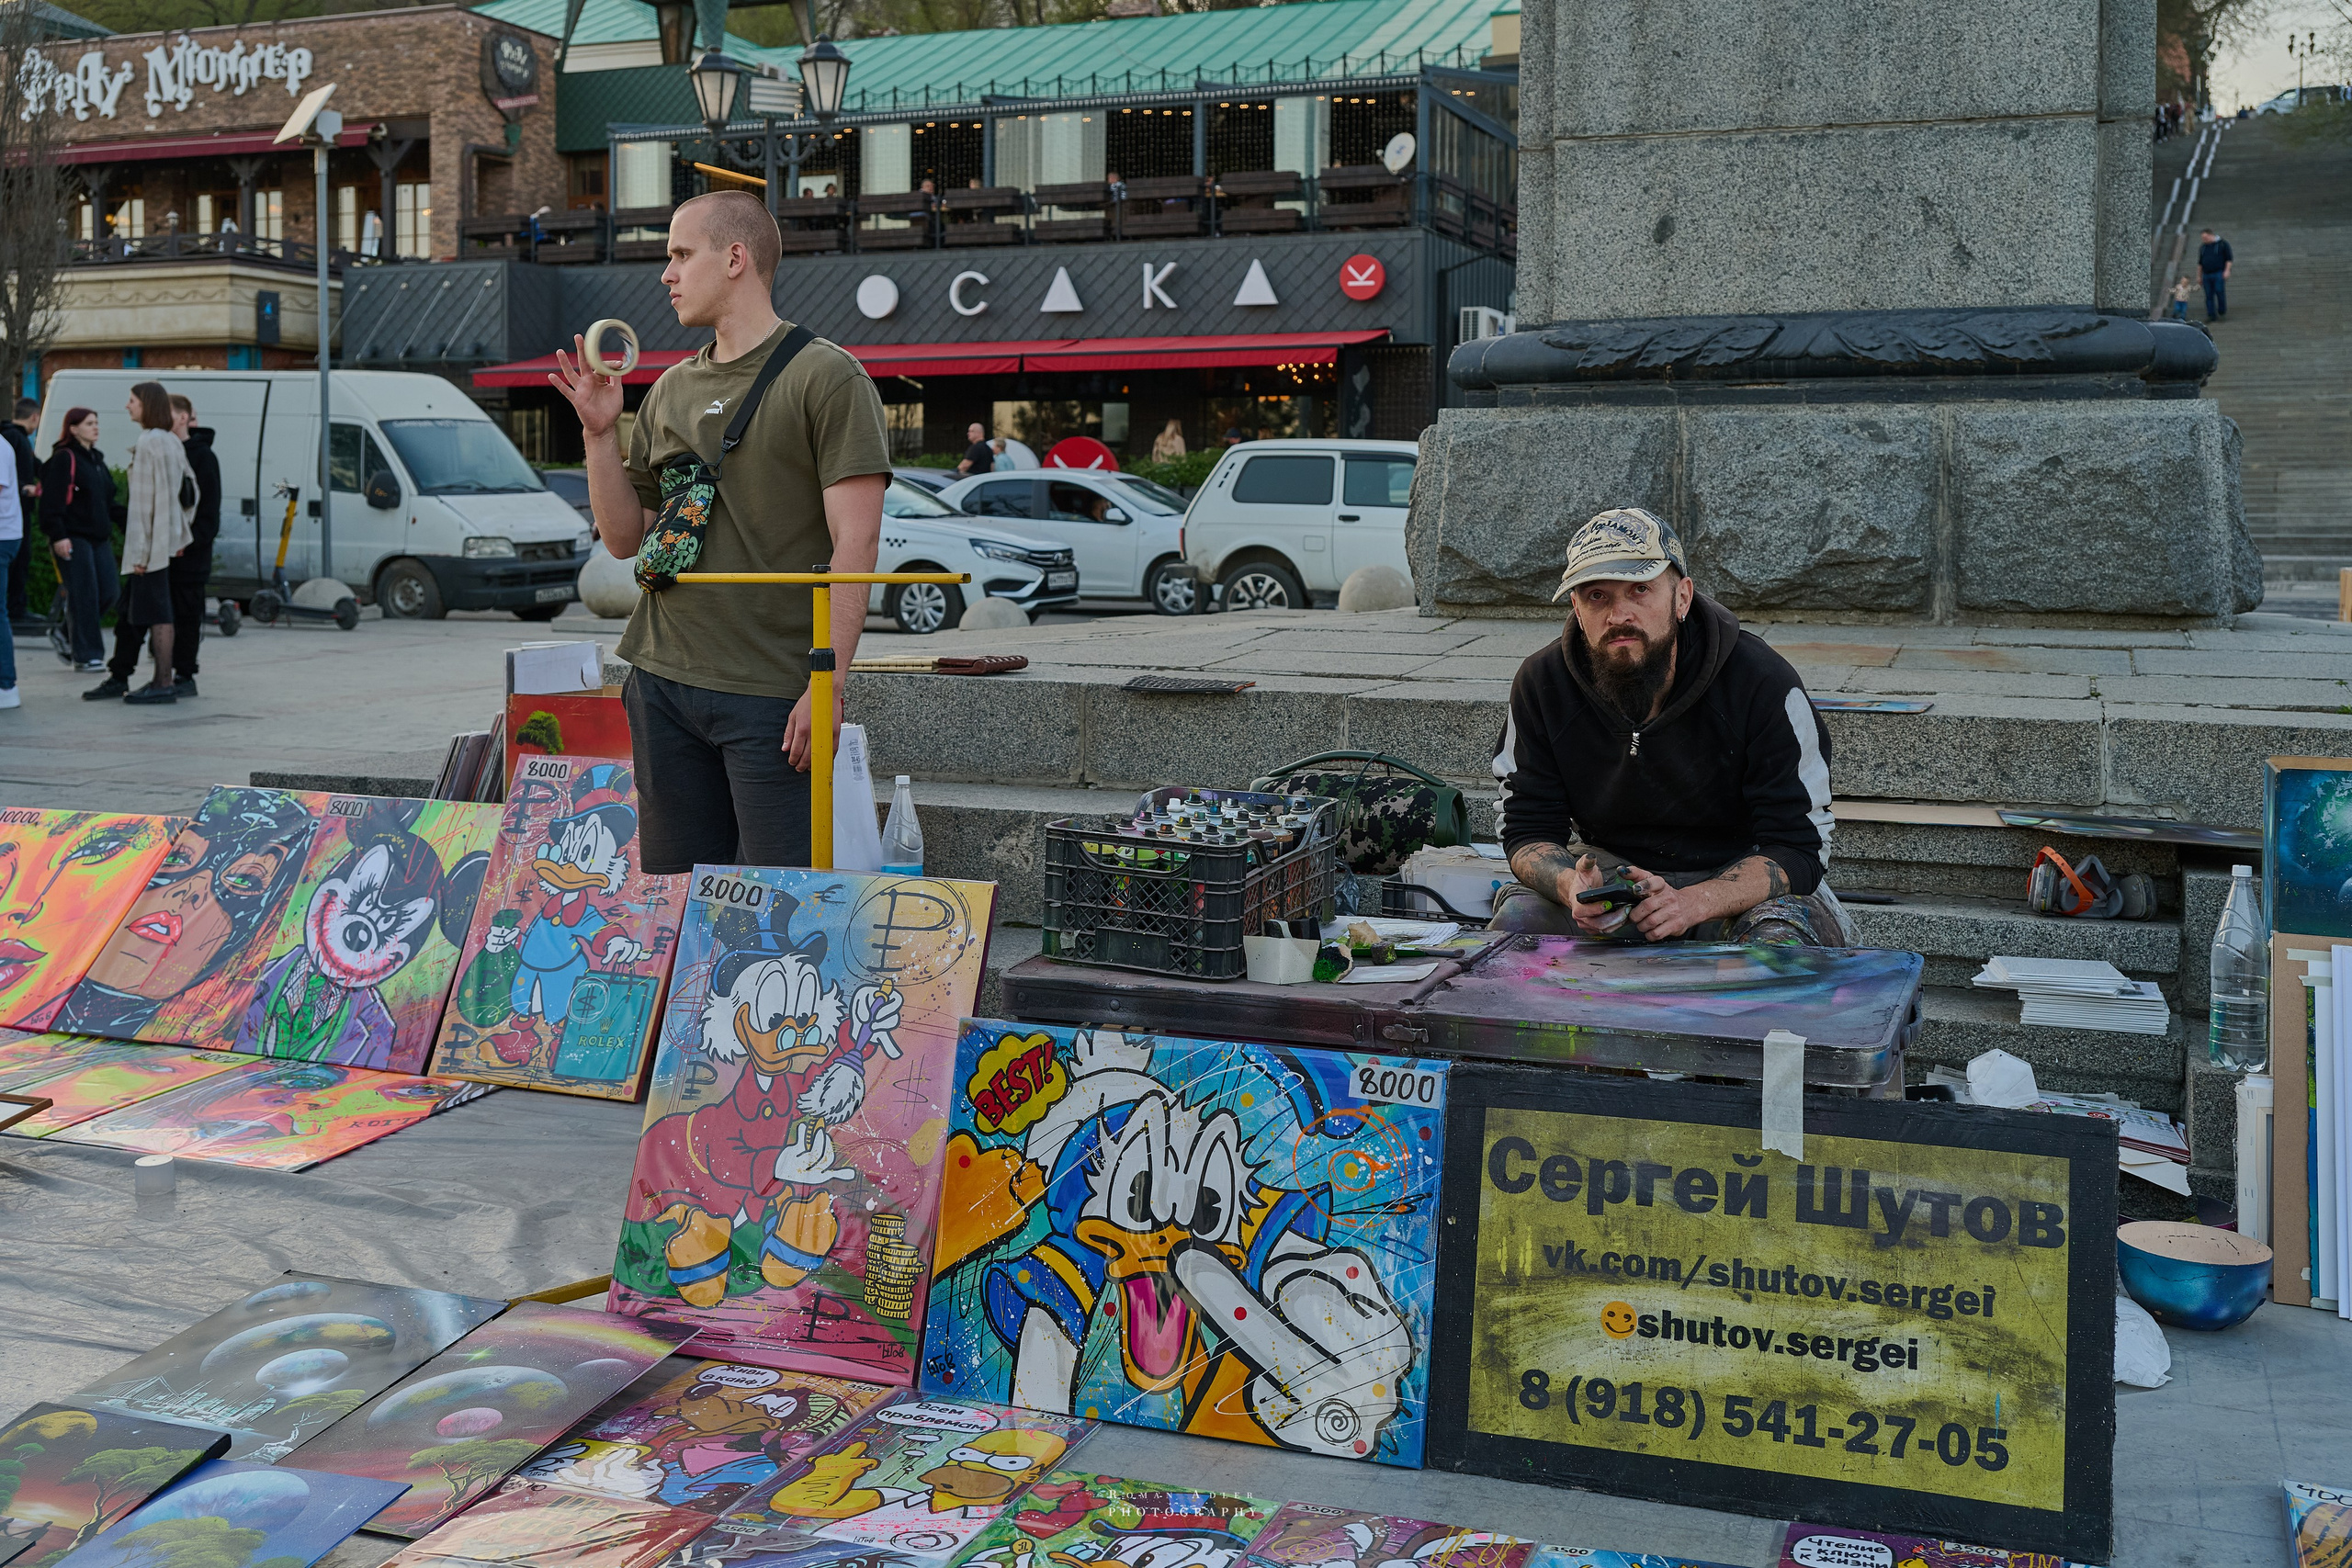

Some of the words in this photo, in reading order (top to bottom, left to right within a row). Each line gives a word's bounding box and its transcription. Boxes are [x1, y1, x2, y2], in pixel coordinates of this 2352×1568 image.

[527, 761, 568, 779] 8000
[700, 874, 763, 907] 8000
[578, 1034, 628, 1050] ROLEX
[974, 1038, 1057, 1129] BEST!
[1359, 1067, 1435, 1103] 8000
[1487, 1135, 1769, 1219] Сергей
[1795, 1164, 2067, 1250] Шутов
[1543, 1239, 1996, 1320] vk.com/shutov.sergei
[1637, 1310, 1918, 1373] shutov.sergei
[846, 1383, 881, 1393] 3500
[915, 1402, 966, 1416] Всем
[878, 1409, 987, 1431] проблемам
[1519, 1370, 1551, 1411] 8
[1565, 1375, 1706, 1441] (918)
[1722, 1394, 2008, 1472] 541-27-05
[1300, 1505, 1342, 1516] 3500
[720, 1525, 756, 1534] 3500
[1550, 1545, 1589, 1555] 3500
[1952, 1543, 2000, 1557] 3500
